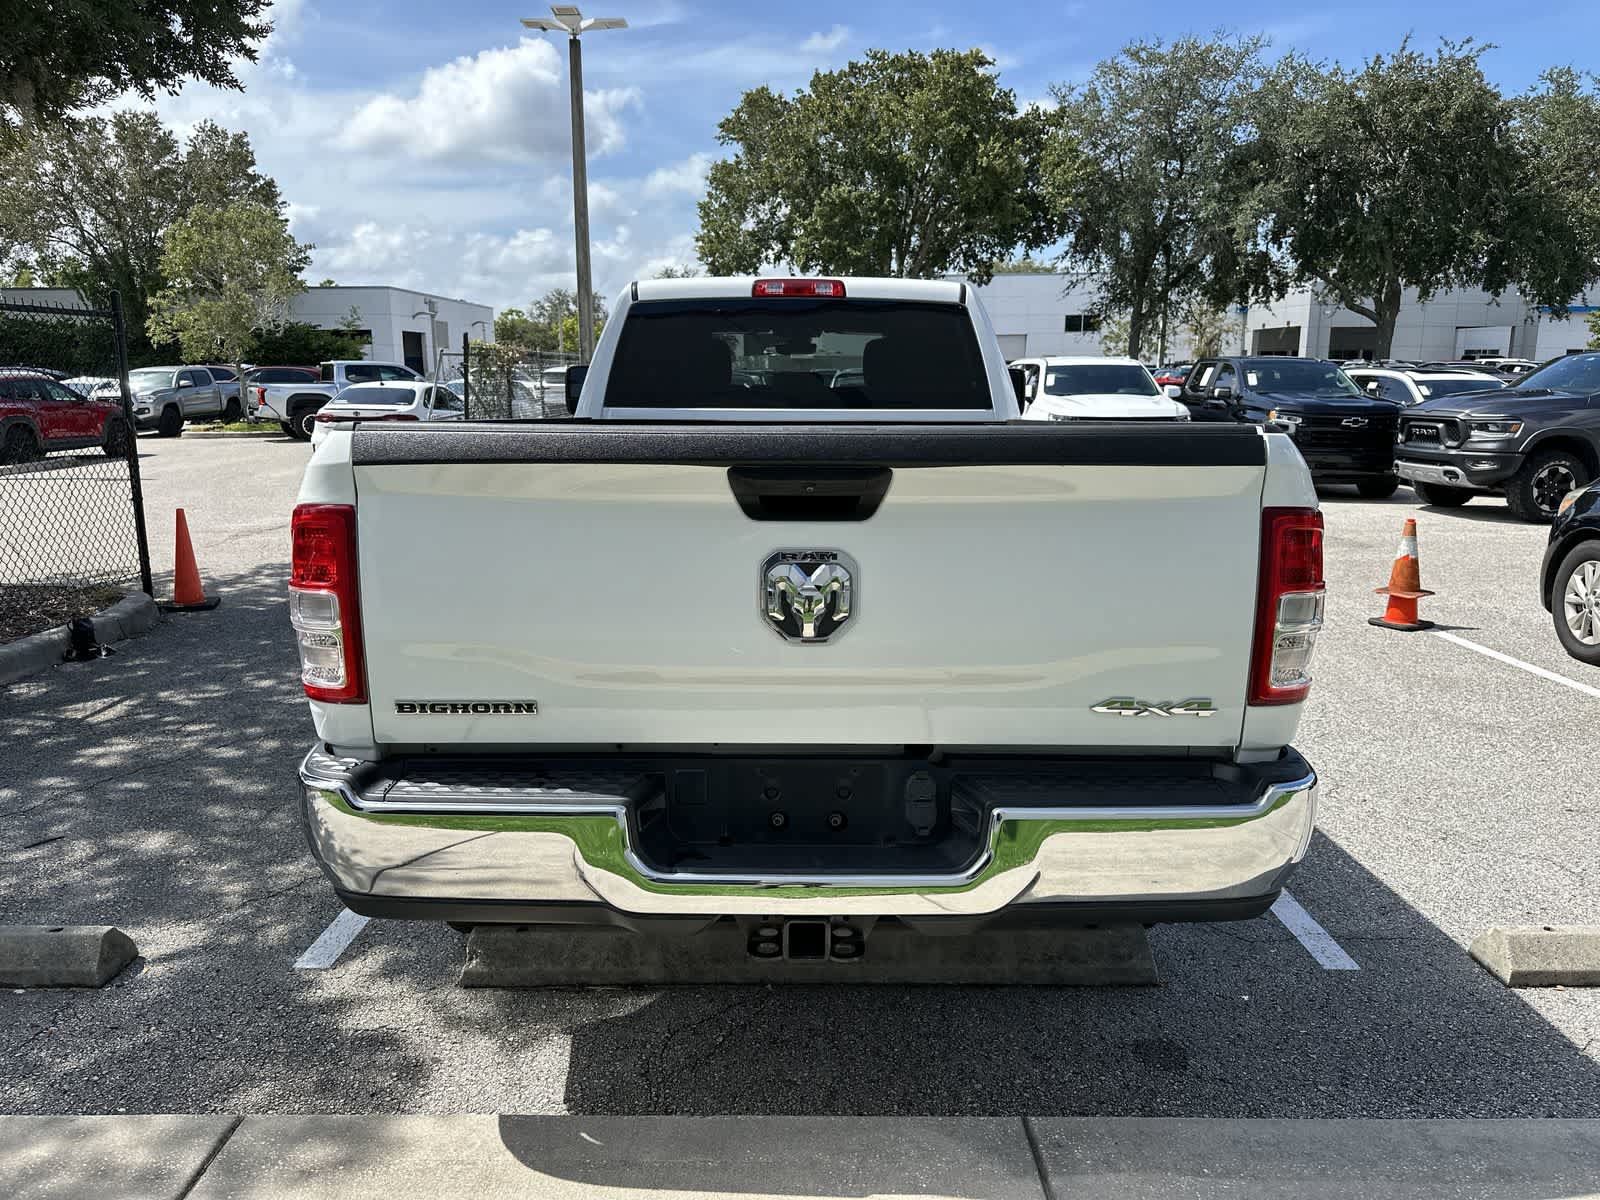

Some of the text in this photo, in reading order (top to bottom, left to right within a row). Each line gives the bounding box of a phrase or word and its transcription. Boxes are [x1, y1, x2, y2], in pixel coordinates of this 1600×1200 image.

[1411, 428, 1437, 436] RAM
[780, 551, 838, 562] RAM
[395, 700, 537, 715] BIGHORN
